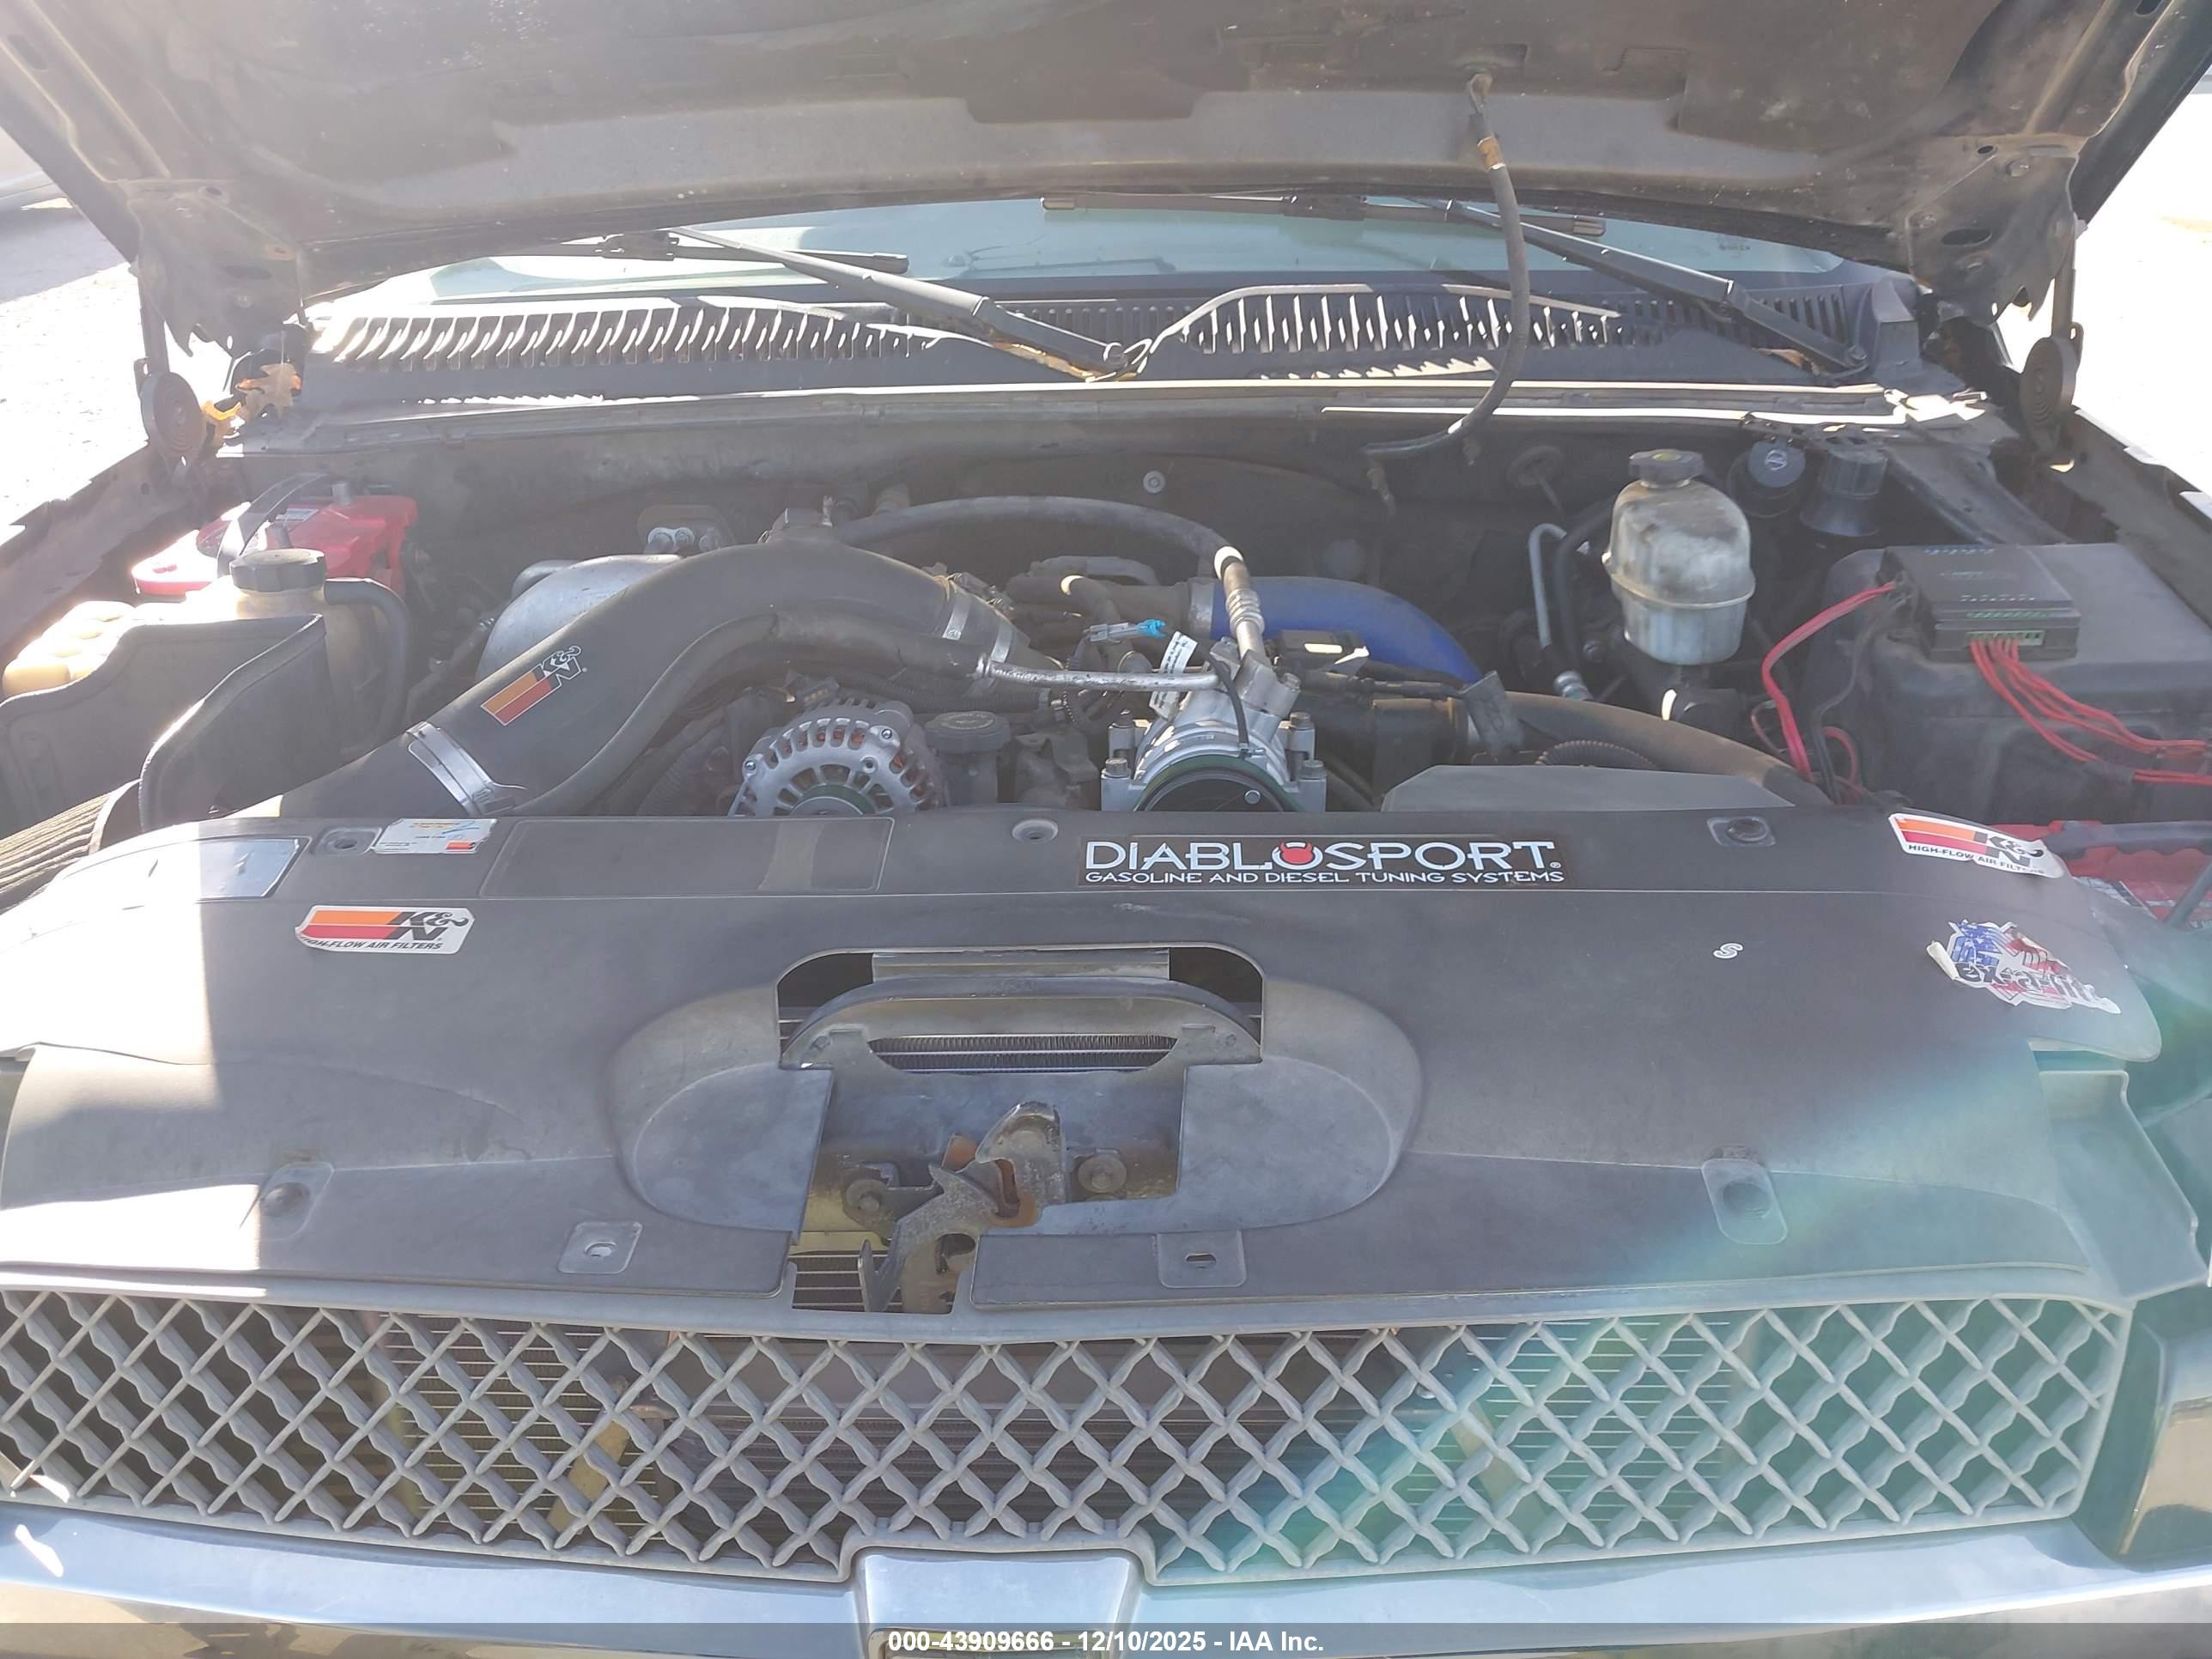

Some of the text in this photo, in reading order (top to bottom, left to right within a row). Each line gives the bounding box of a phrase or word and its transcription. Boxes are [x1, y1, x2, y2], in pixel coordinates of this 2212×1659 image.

[1085, 842, 1556, 871] DIABLOSPORT
[1908, 844, 1973, 860] HIGH-FLOW
[1978, 856, 1997, 866] AIR
[1085, 871, 1565, 884] GASOLINE AND DIESEL TUNING SYSTEMS
[386, 911, 469, 941] K&N
[367, 941, 392, 950] AIR
[392, 941, 444, 951] FILTERS
